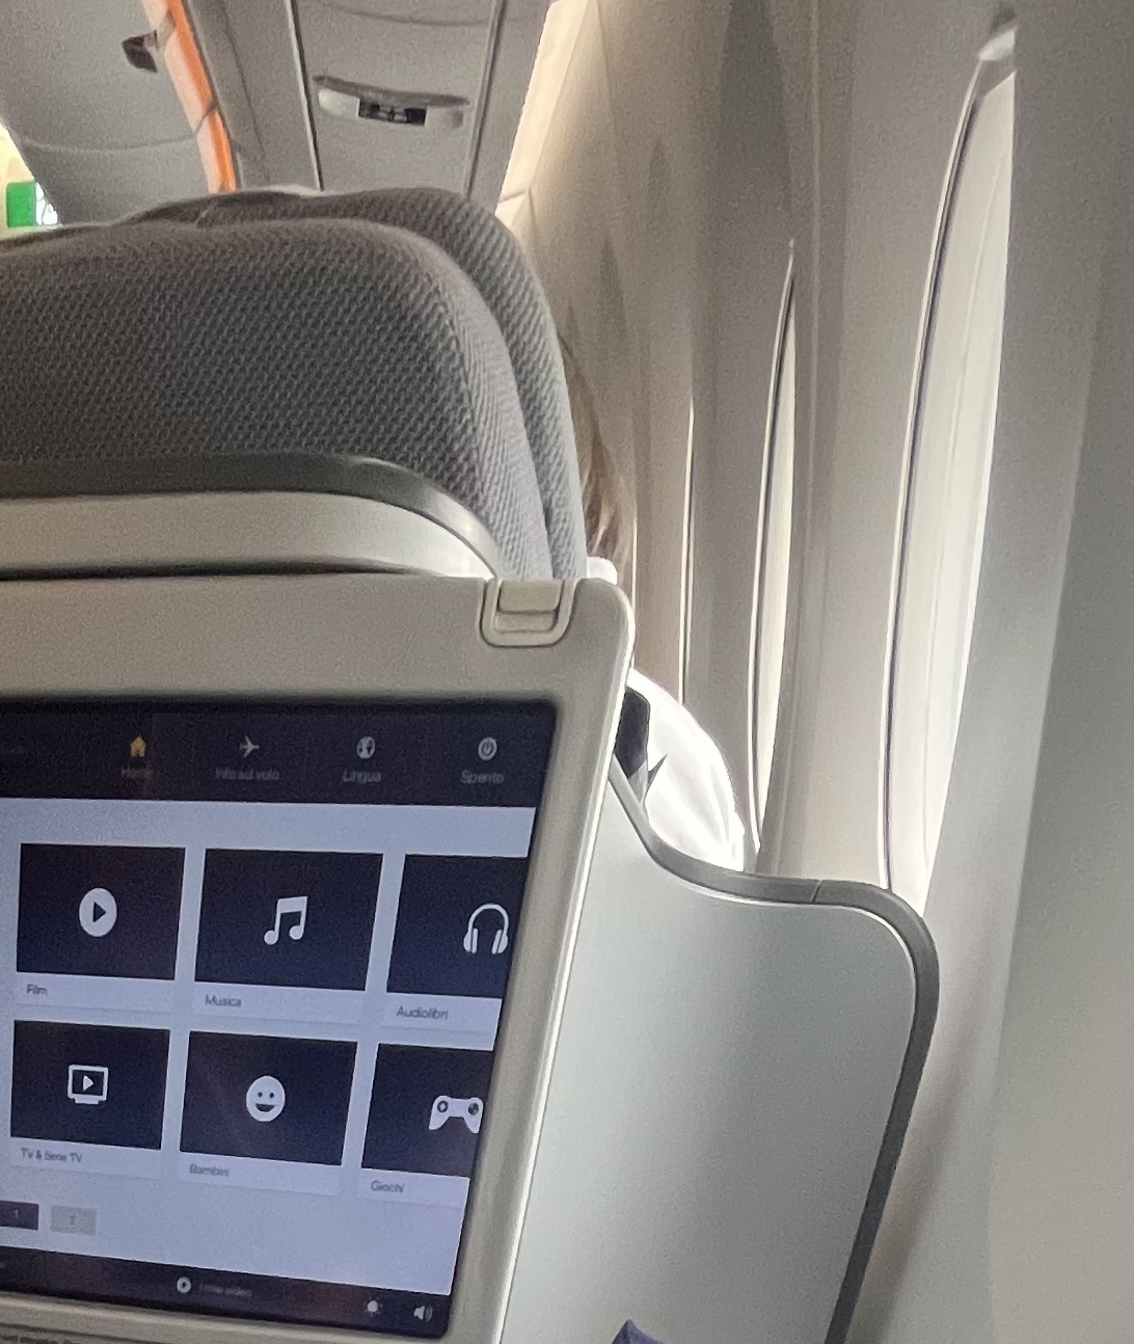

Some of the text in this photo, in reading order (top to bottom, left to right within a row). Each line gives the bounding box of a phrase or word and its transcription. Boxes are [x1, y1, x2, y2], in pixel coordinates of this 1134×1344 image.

[26, 983, 48, 996] Film
[204, 993, 242, 1008] Musica
[396, 1005, 449, 1020] Audiolibri
[189, 1163, 230, 1177] Bambini
[370, 1179, 405, 1193] Giochi
